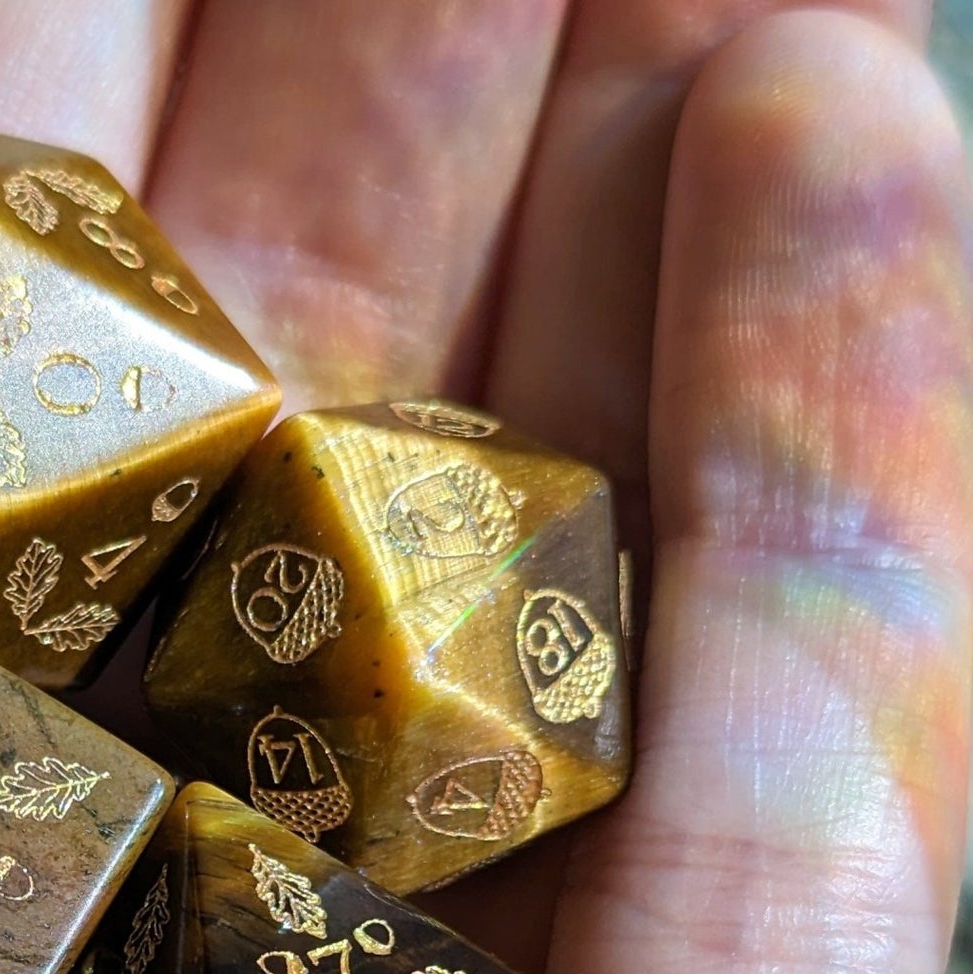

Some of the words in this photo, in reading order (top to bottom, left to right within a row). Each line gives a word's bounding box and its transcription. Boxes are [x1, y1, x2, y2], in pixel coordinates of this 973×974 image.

[79, 217, 145, 269] 8
[82, 535, 146, 589] 4
[247, 551, 309, 632] 20
[526, 601, 585, 676] 18
[259, 733, 324, 785] 14
[430, 776, 491, 816] 4
